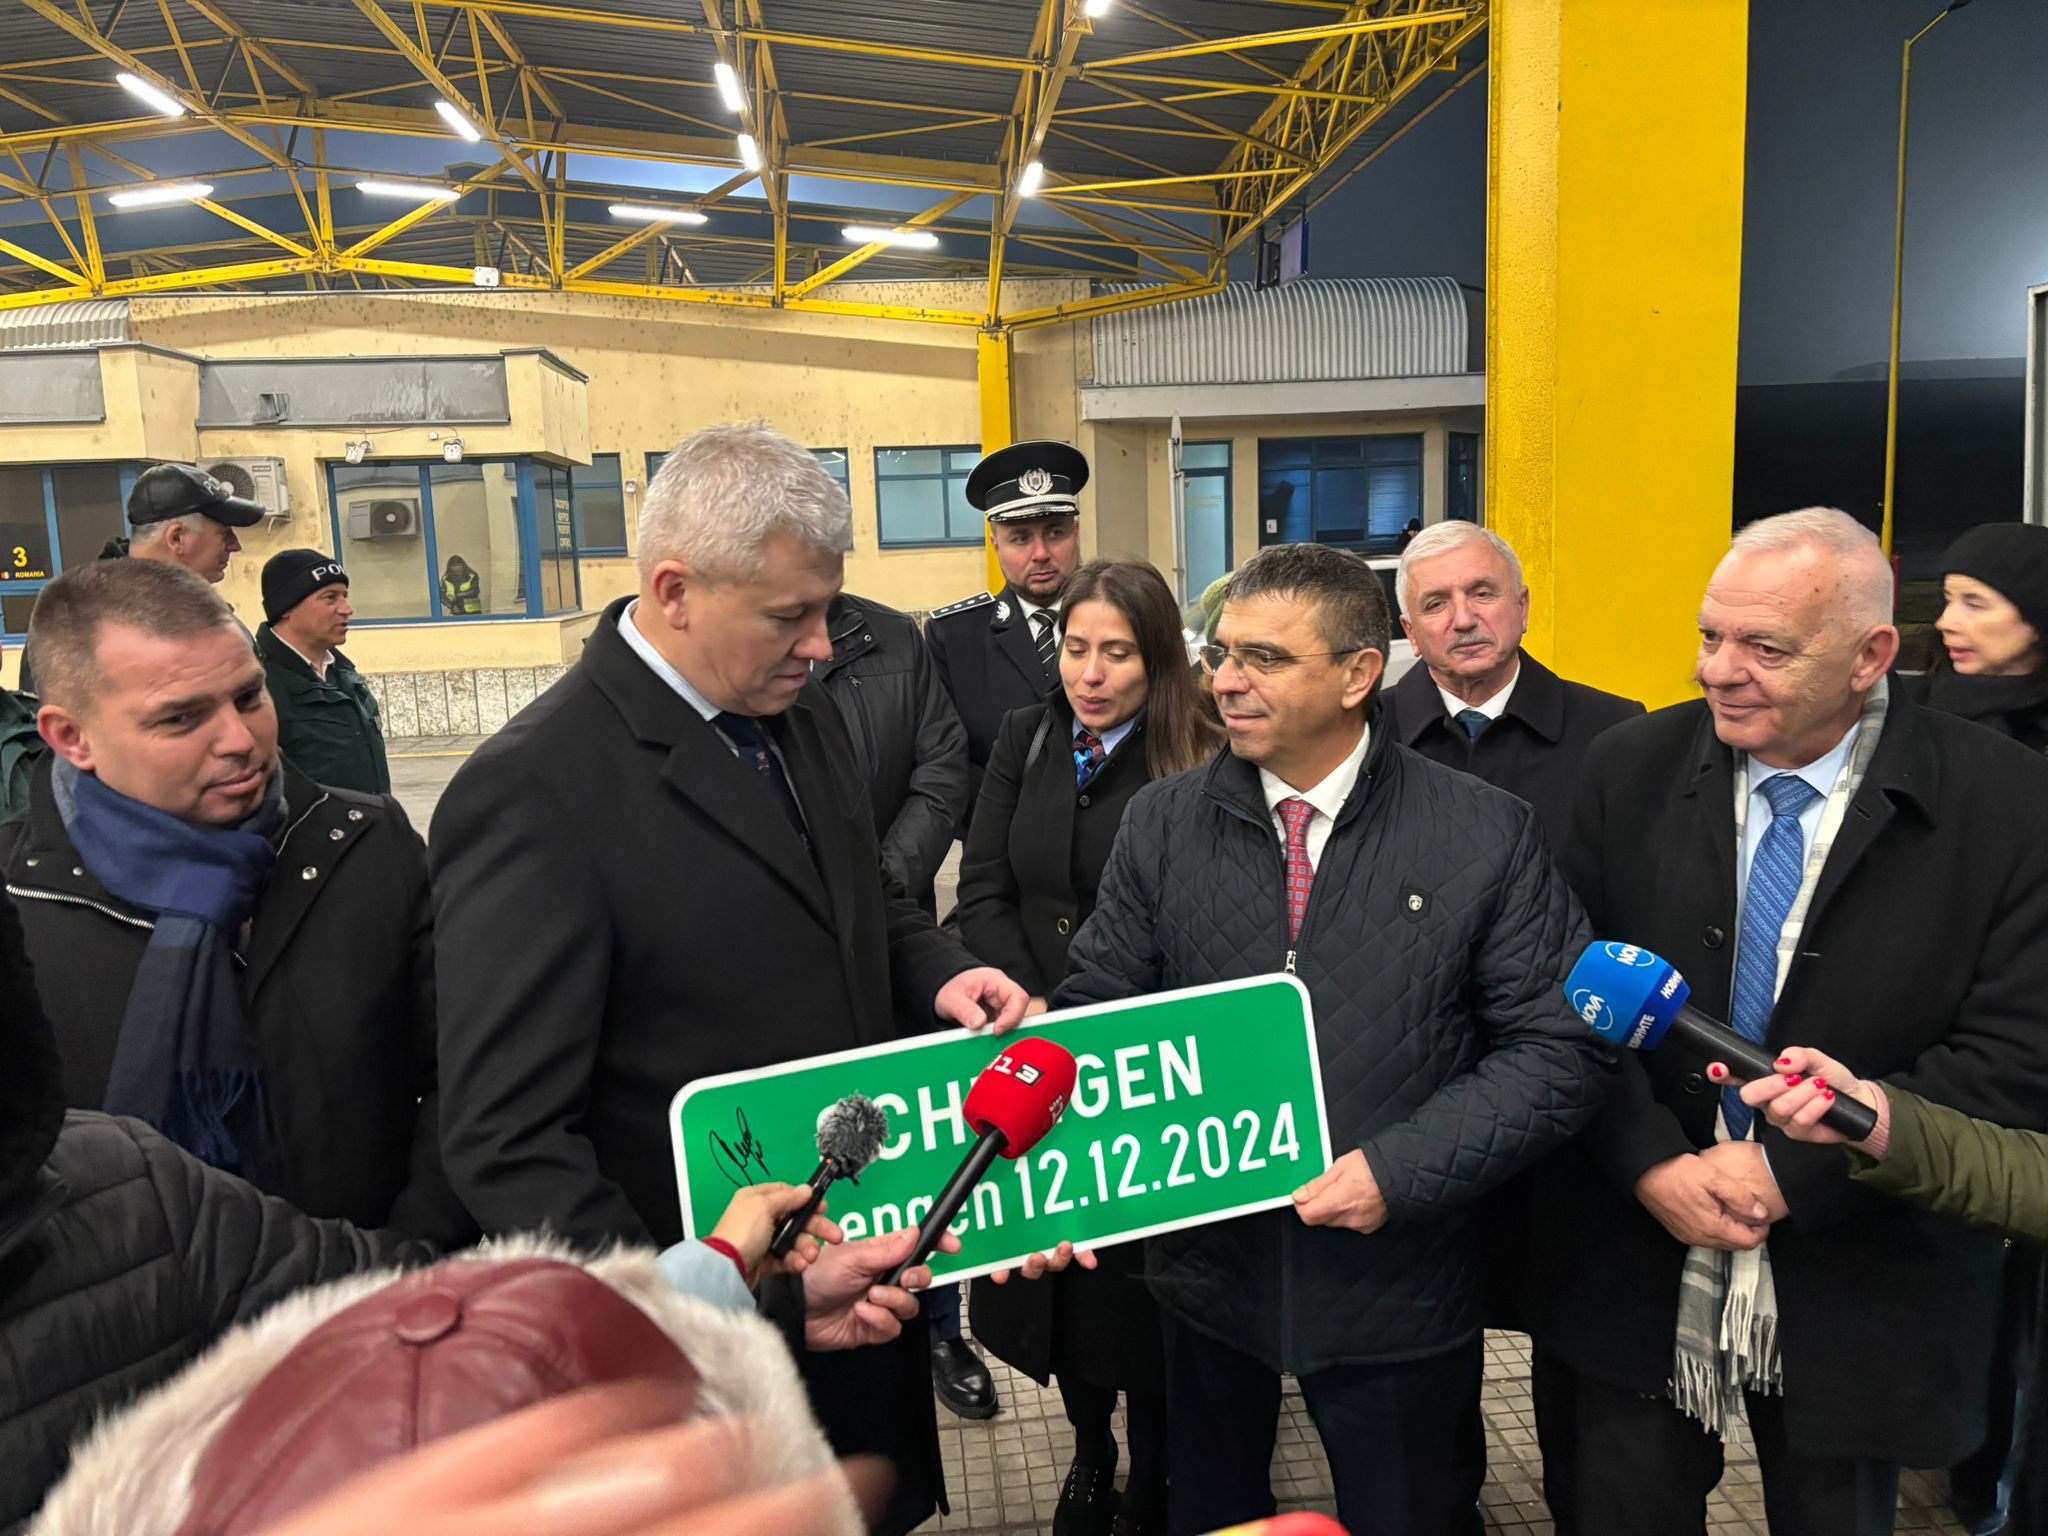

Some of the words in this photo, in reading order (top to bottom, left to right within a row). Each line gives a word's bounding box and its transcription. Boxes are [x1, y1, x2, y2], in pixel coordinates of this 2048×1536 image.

[13, 547, 28, 568] 3
[15, 571, 45, 579] ROMANIA
[817, 1035, 1203, 1162] CHGEN
[1014, 1101, 1300, 1219] 12.12.2024
